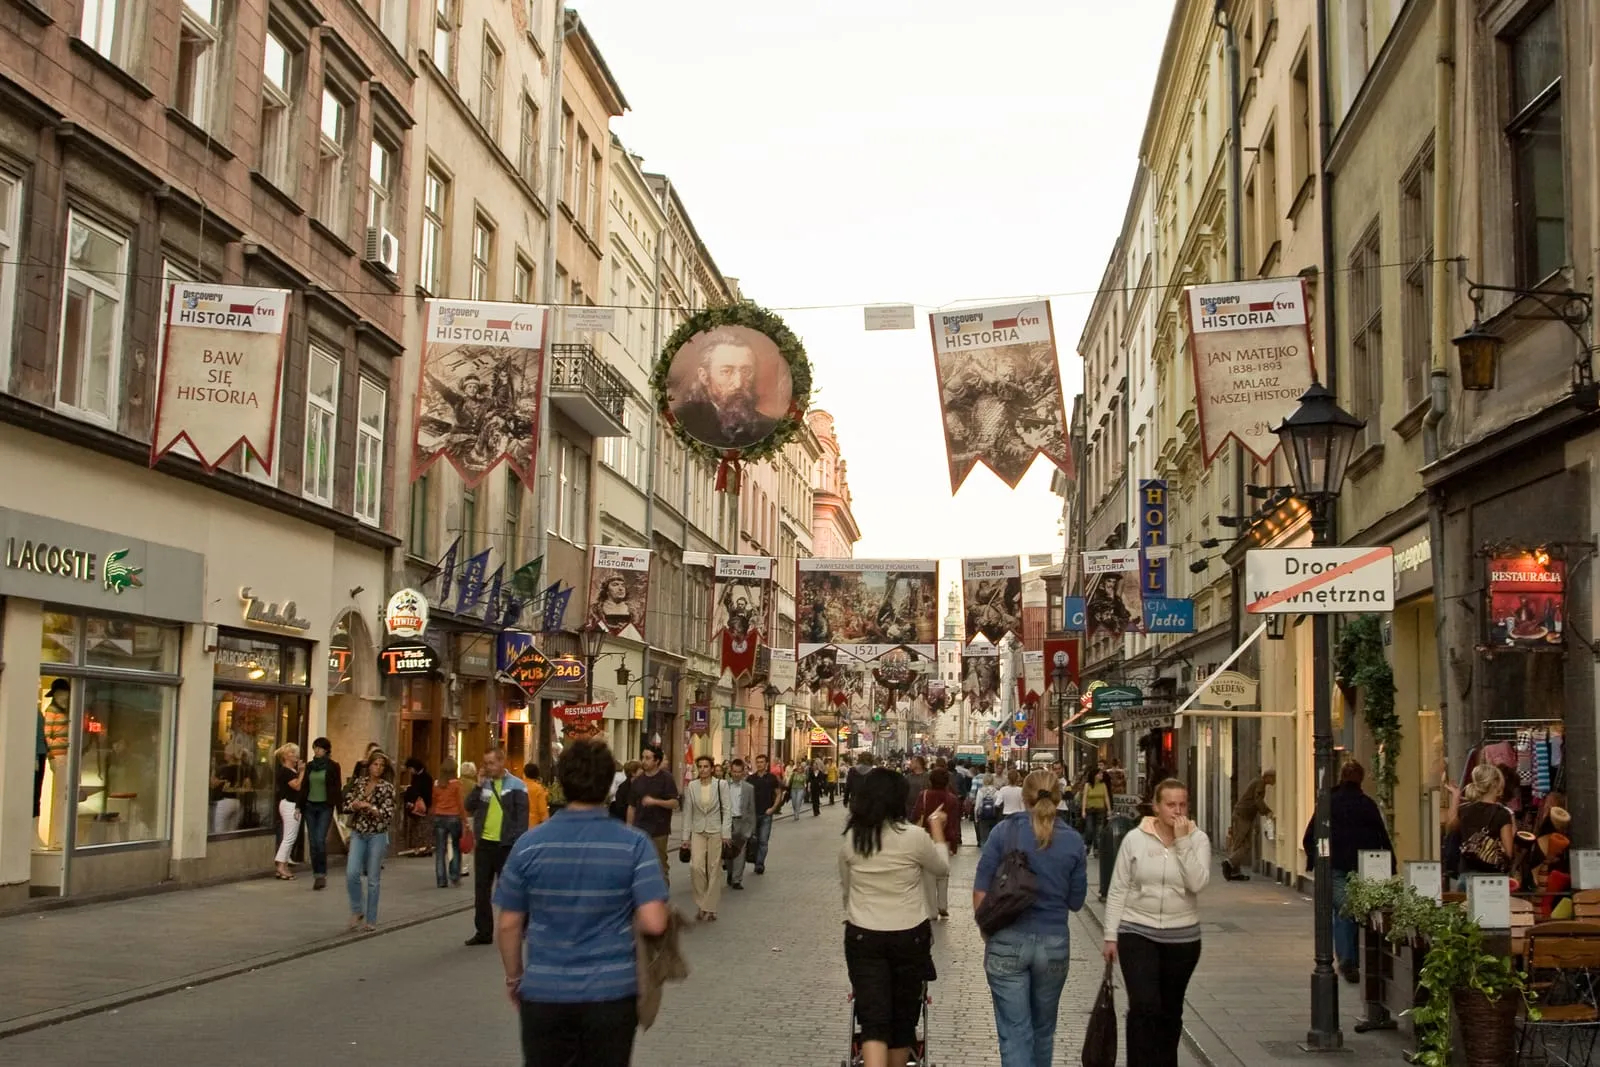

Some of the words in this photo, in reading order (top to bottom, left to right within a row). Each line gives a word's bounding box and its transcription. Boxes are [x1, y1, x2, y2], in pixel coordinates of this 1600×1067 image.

[183, 290, 223, 302] Discovery
[1200, 296, 1240, 305] Discovery
[257, 307, 275, 316] tvn
[1277, 301, 1295, 310] tvn
[439, 306, 479, 318] Discovery
[180, 310, 252, 327] HISTORIA
[943, 313, 983, 325] Discovery
[1020, 316, 1039, 326] tvn
[1202, 312, 1276, 328] HISTORIA
[515, 323, 533, 331] tvn
[436, 327, 510, 343] HISTORIA
[945, 328, 1020, 348] HISTORIA
[202, 349, 243, 366] BAW
[1208, 351, 1231, 366] JAN
[1237, 346, 1298, 361] MATEJKO
[1228, 362, 1282, 374] 1838-1893
[207, 369, 232, 387] SIĘ
[1233, 377, 1280, 390] MALARZ
[177, 386, 259, 408] HISTORIĄ
[1210, 392, 1250, 405] NASZEJ
[1147, 489, 1163, 589] HOTEL
[6, 537, 97, 581] LACOSTE
[598, 559, 634, 569] HISTORIA
[720, 568, 756, 578] HISTORIA
[1088, 563, 1125, 572] HISTORIA
[968, 570, 1005, 578] HISTORIA
[1491, 571, 1561, 582] RESTAURACJA
[1150, 614, 1186, 629] Jadło
[854, 645, 878, 656] 1521
[382, 651, 433, 675] Tower
[520, 666, 544, 681] PUB
[555, 665, 581, 677] BAB
[1210, 684, 1245, 696] KREDENS
[564, 705, 605, 716] RESTAURANT
